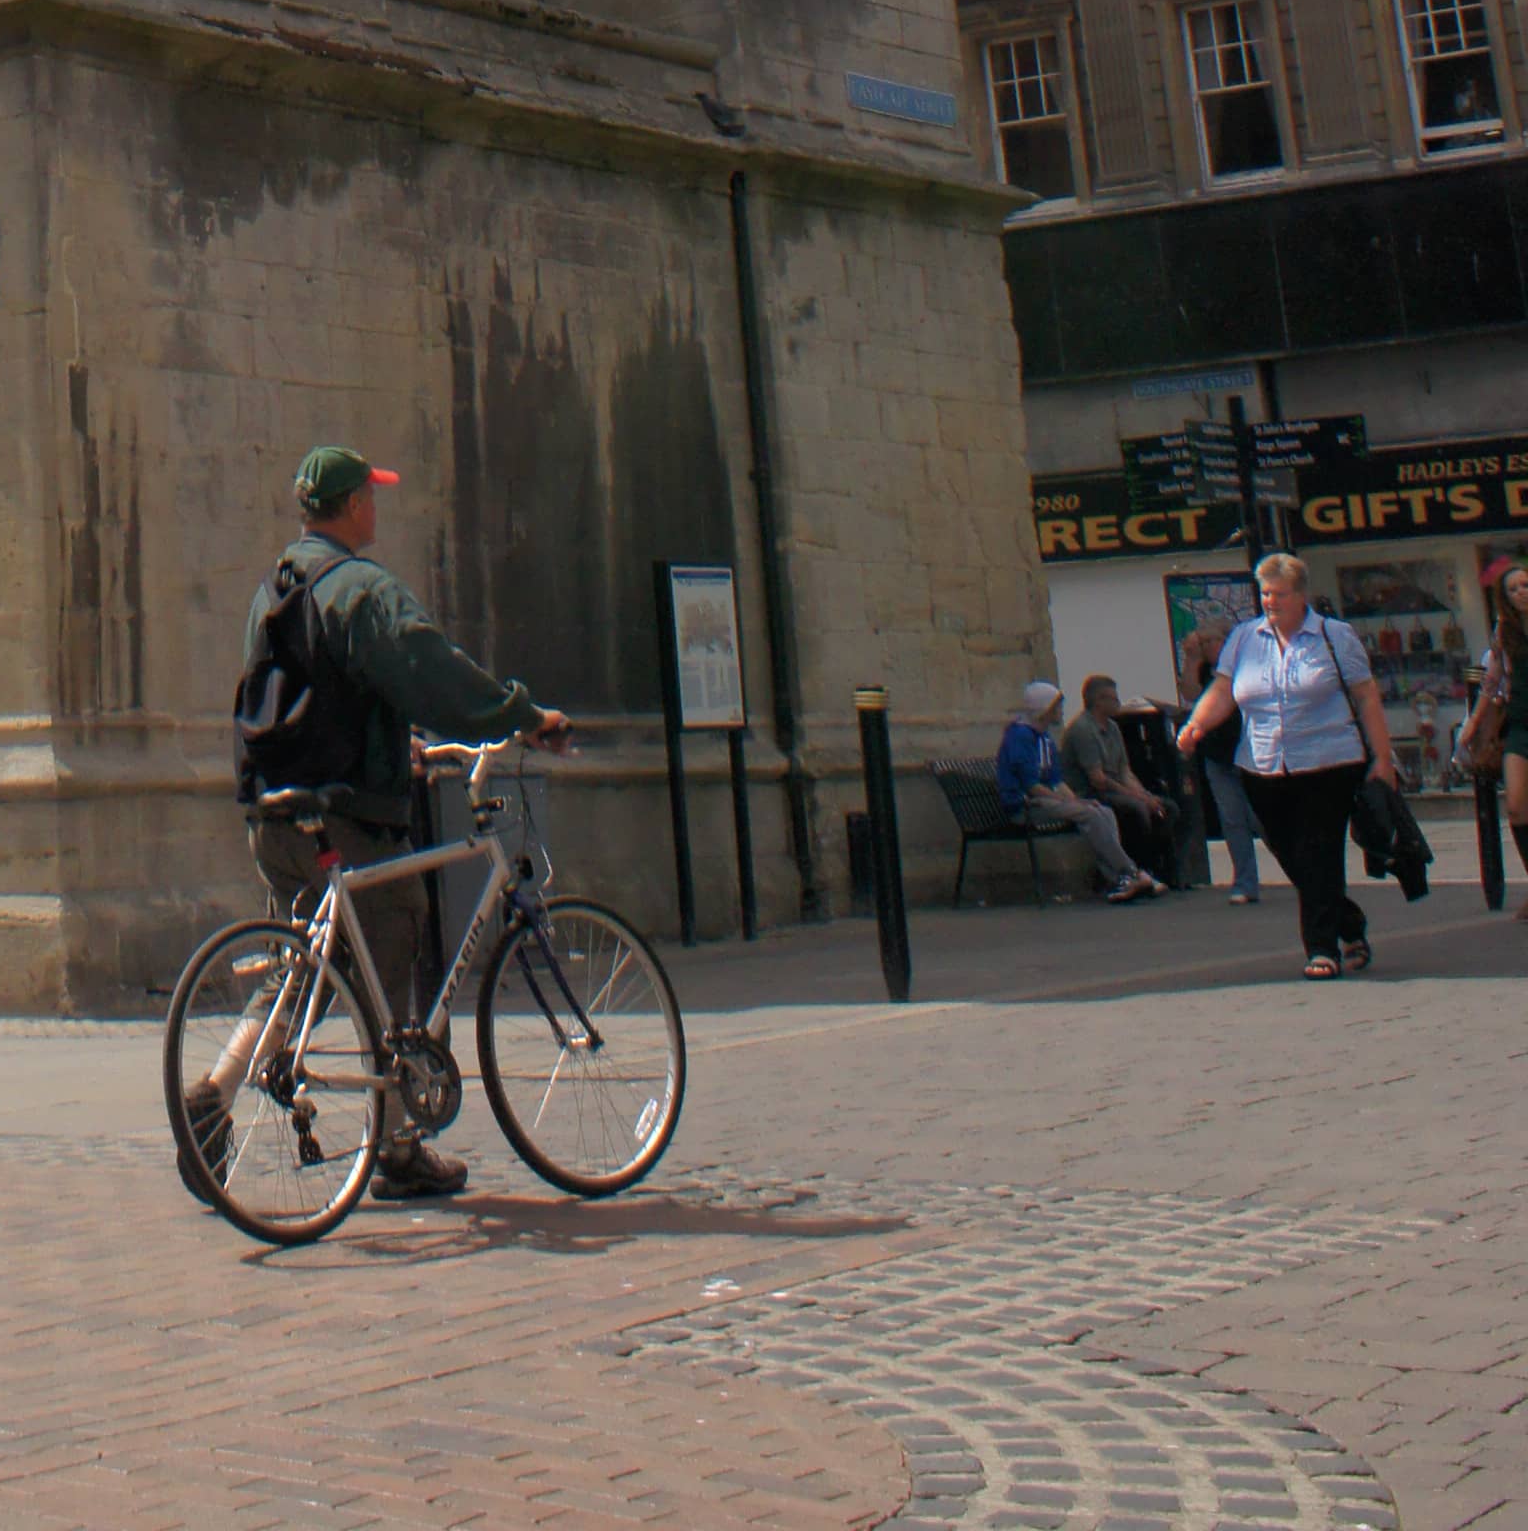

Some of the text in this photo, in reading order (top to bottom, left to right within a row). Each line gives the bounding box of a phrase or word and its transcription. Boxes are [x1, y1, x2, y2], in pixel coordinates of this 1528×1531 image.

[1398, 456, 1501, 483] HADLEYS
[1303, 483, 1485, 534] GIFT'S
[441, 913, 484, 1012] MARIN
